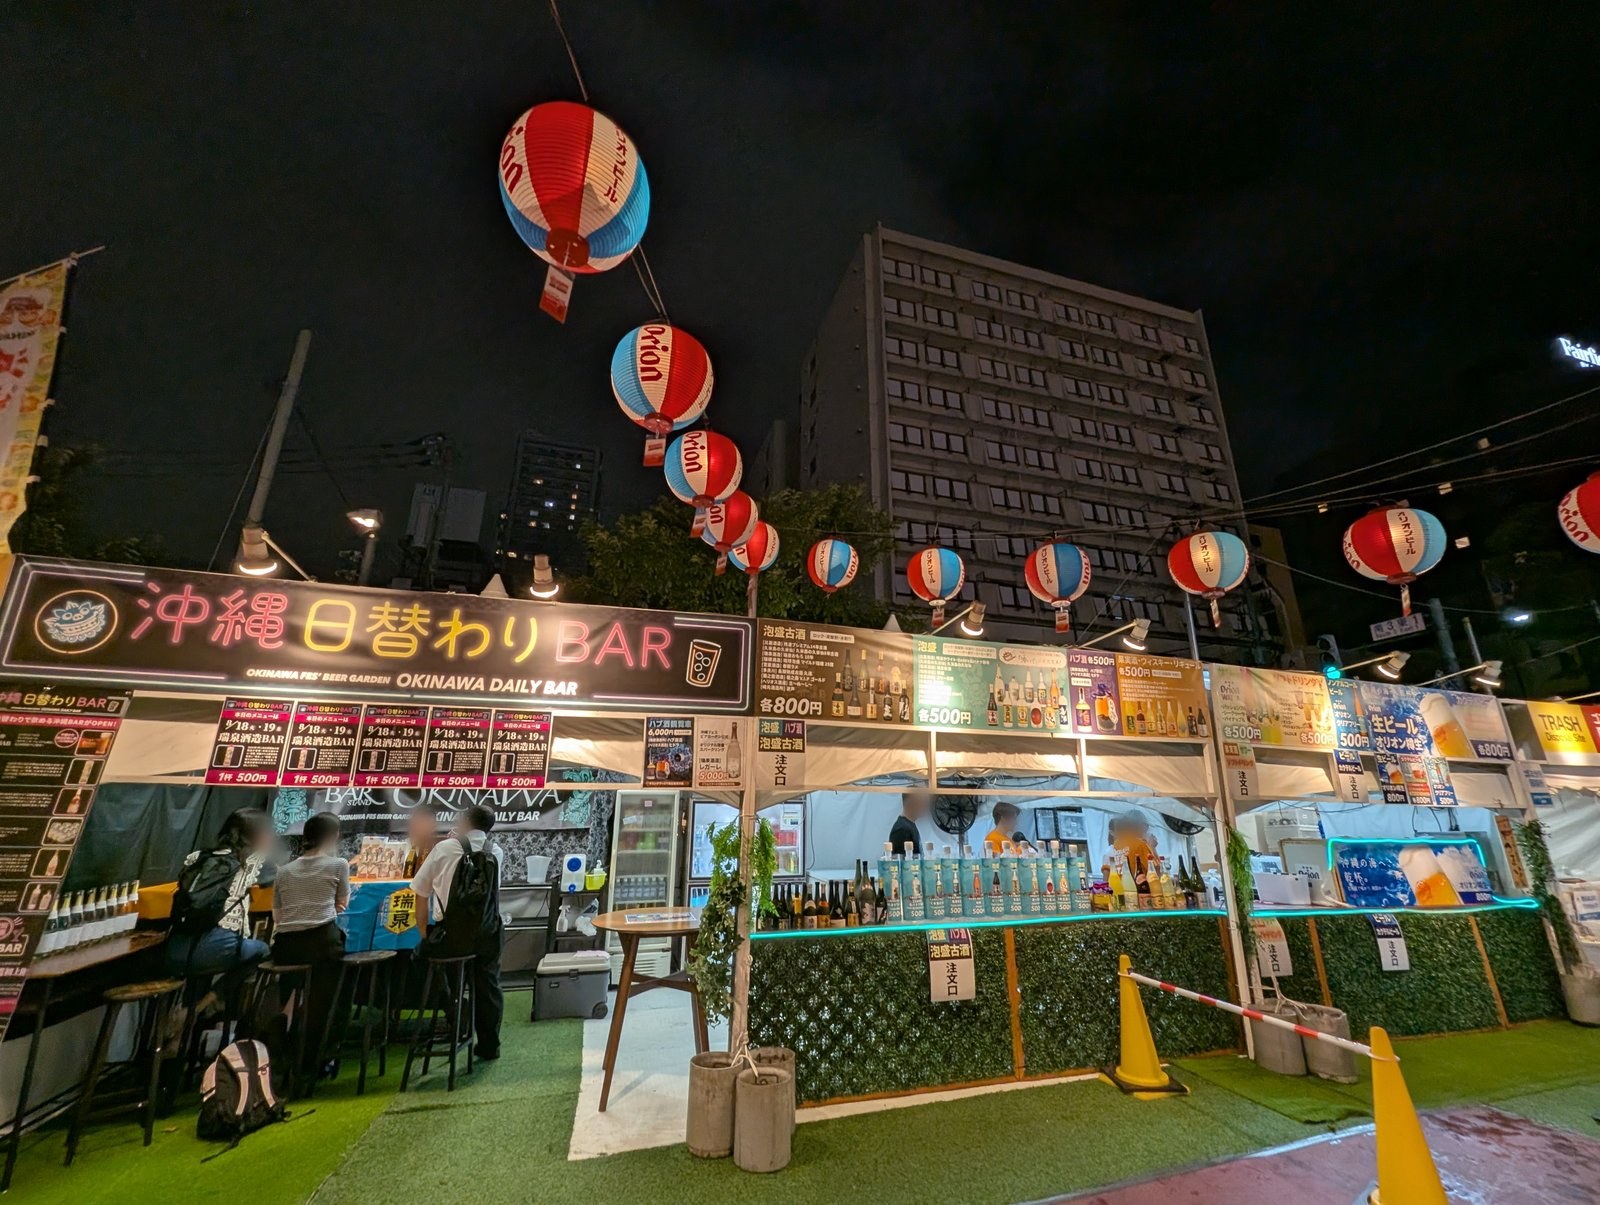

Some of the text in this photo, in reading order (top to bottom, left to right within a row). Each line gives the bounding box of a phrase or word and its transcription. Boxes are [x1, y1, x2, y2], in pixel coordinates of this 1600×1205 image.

[763, 625, 806, 640] 泡盛古酒
[1119, 667, 1151, 678] 各500円
[246, 668, 298, 680] OKINAWA
[323, 673, 348, 683] BEER
[349, 674, 390, 685] GARDEN
[396, 673, 486, 692] OKINAWA
[489, 677, 542, 694] DAILY
[543, 681, 577, 696] BAR
[1329, 688, 1343, 696] ビール
[760, 697, 822, 716] 各800円
[918, 708, 971, 725] 各500円
[761, 721, 780, 734] 泡盛
[1371, 714, 1419, 735] 生ビール
[1538, 714, 1583, 733] TRASH
[218, 732, 285, 744] 瑞泉酒造BAR
[648, 728, 673, 737] 6,000円
[1224, 726, 1261, 739] 各500円
[291, 736, 355, 747] 瑞泉酒造BAR
[362, 738, 423, 748] 瑞泉酒造BAR
[429, 739, 487, 750] 瑞泉酒造BAR
[492, 741, 547, 752] 瑞泉酒造BAR
[760, 737, 803, 750] 泡盛古酒
[1340, 732, 1370, 748] 500円
[1339, 751, 1355, 760] ビール
[1478, 743, 1512, 758] 各800円
[775, 754, 787, 786] 注文口
[236, 773, 268, 782] 500円
[310, 775, 340, 784] 500円
[381, 776, 409, 785] 500円
[448, 776, 475, 786] 500円
[511, 778, 537, 786] 500円
[1238, 770, 1248, 796] 注文口
[1350, 775, 1359, 799] 注文口
[1387, 793, 1406, 802] 800円
[516, 811, 540, 821] BAR
[389, 894, 415, 929] 瑞泉
[930, 944, 970, 958] 泡盛古酒
[1388, 940, 1399, 966] 注文口
[1268, 944, 1280, 972] 注文口
[946, 962, 958, 996] 注文口
